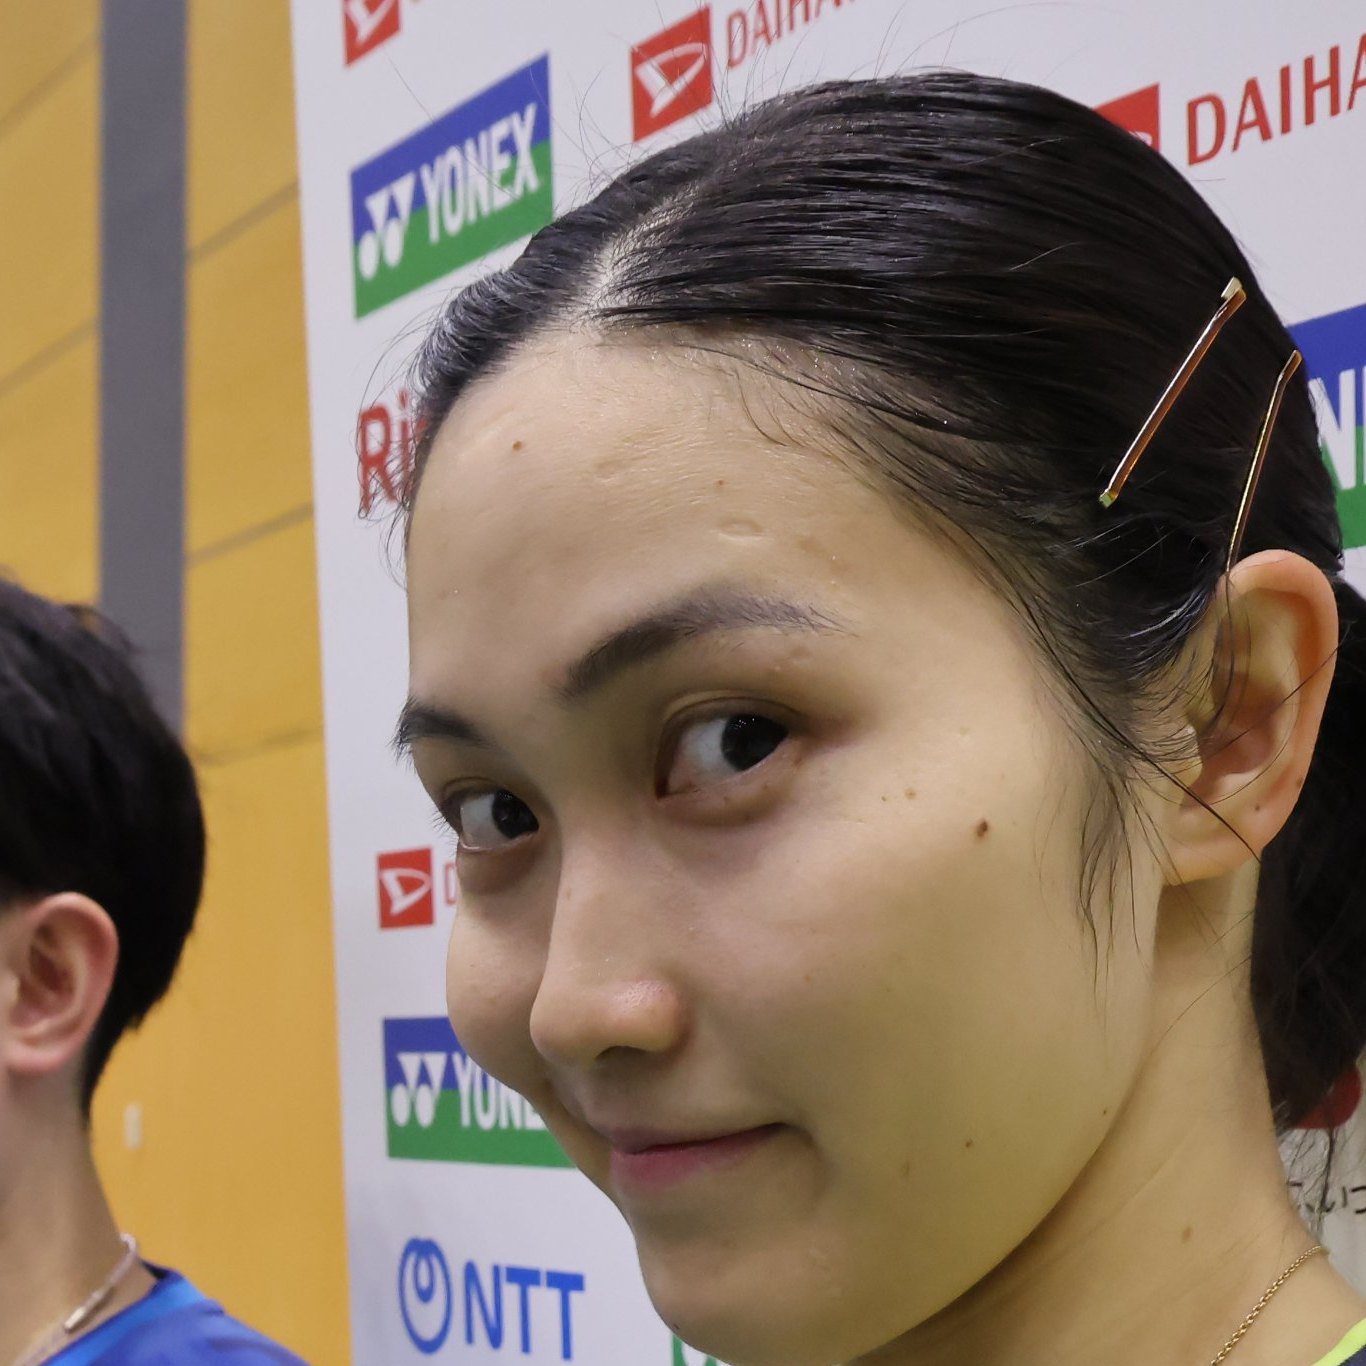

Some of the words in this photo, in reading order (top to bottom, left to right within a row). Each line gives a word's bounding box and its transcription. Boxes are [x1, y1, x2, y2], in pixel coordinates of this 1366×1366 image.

[420, 104, 541, 245] YONEX
[452, 1051, 549, 1131] YON
[464, 1258, 584, 1361] NTT
